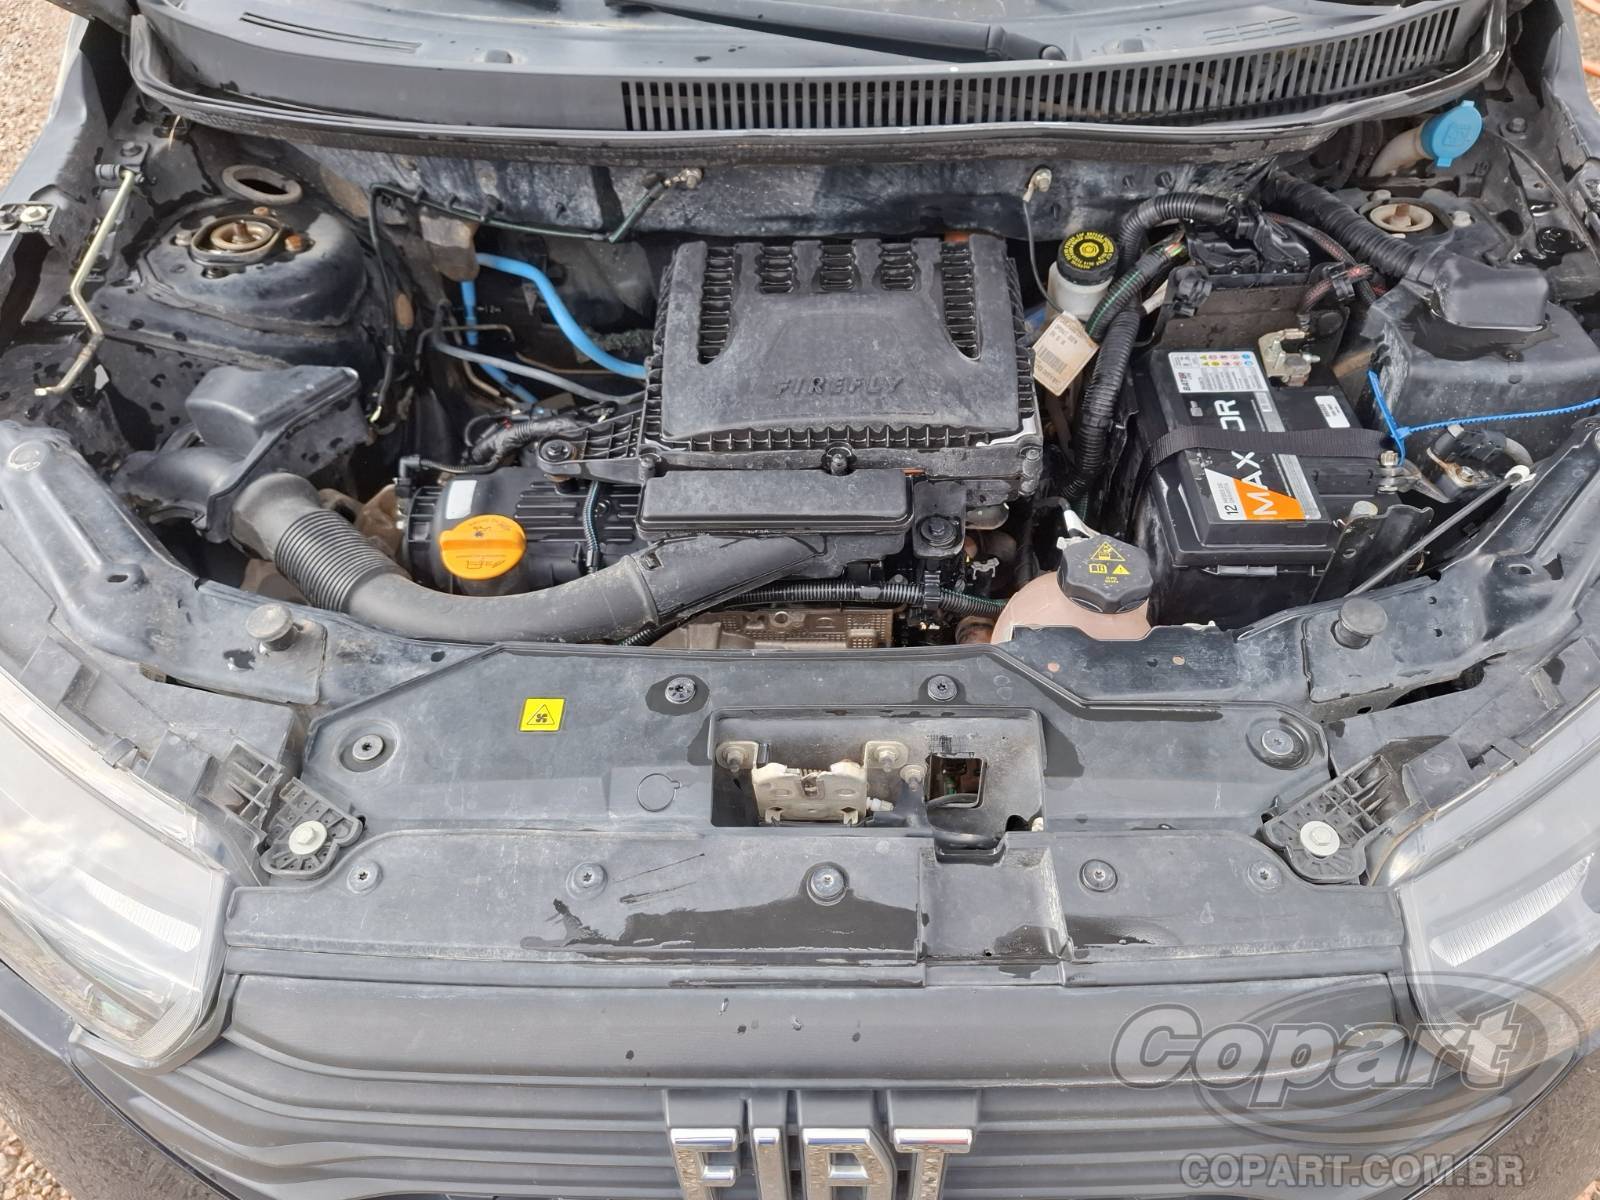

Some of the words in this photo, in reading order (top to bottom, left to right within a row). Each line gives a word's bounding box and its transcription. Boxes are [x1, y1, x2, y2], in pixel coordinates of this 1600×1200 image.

[776, 376, 904, 395] FIREFLY
[1224, 504, 1238, 515] 12
[669, 1127, 974, 1200] FIAT
